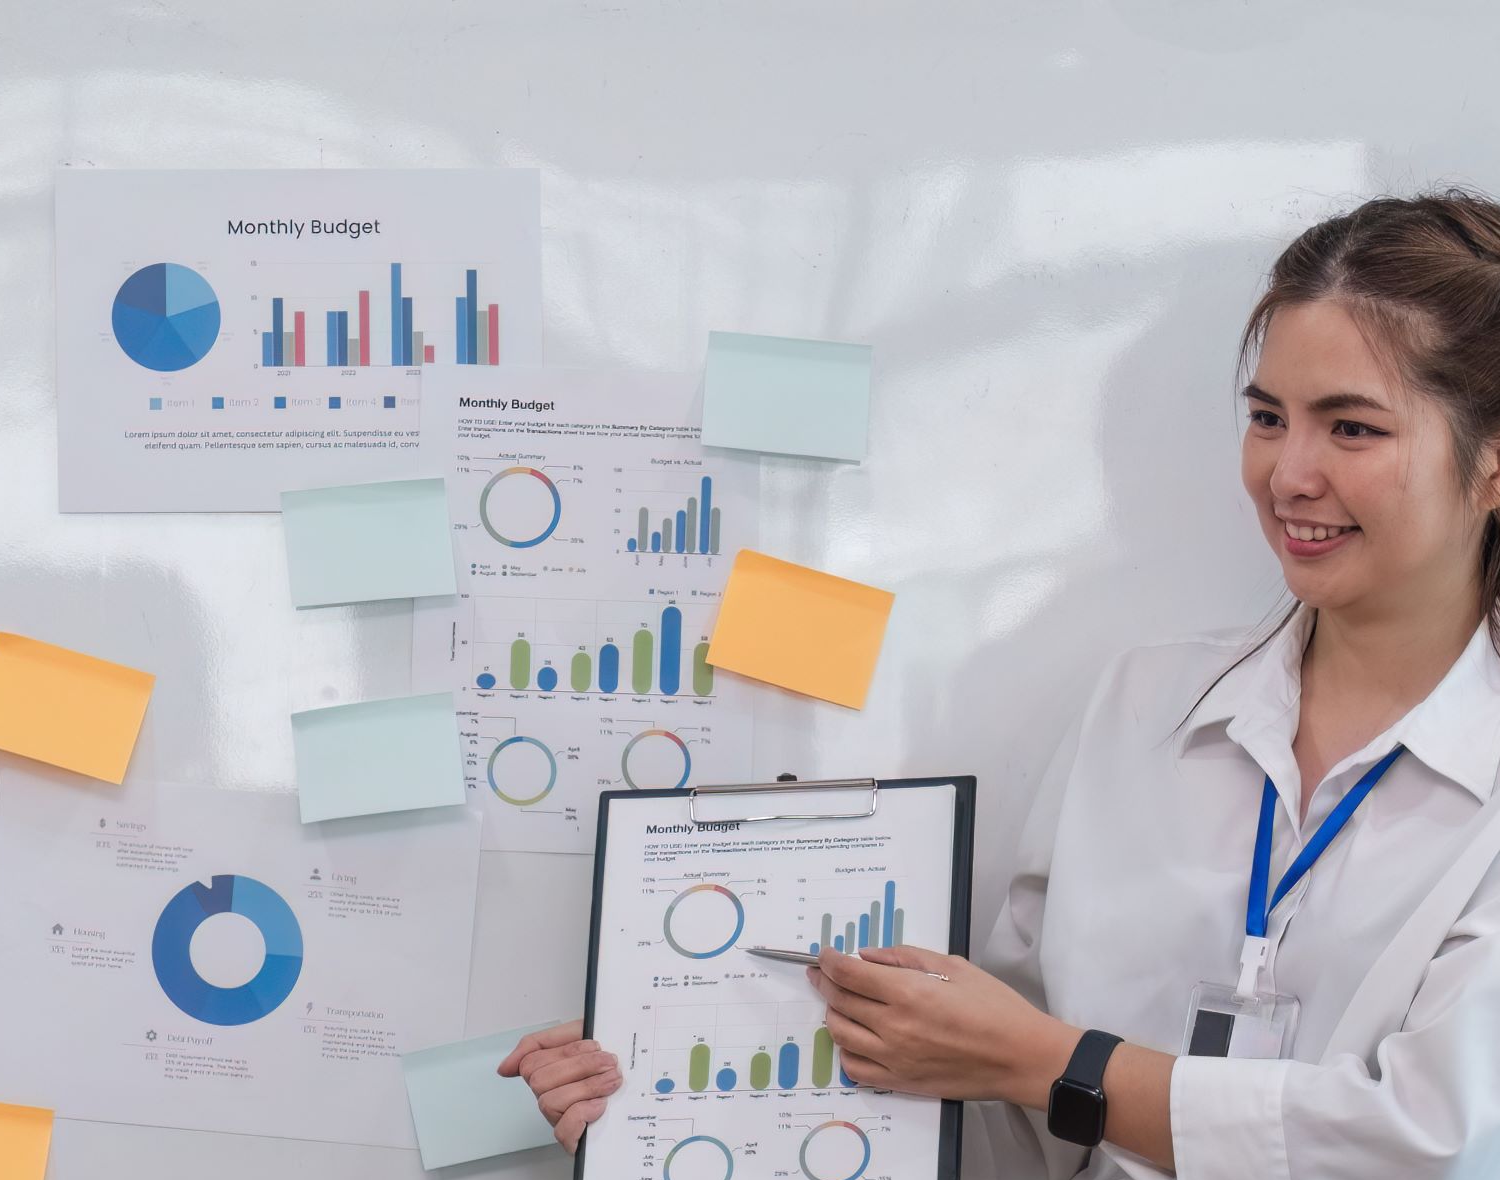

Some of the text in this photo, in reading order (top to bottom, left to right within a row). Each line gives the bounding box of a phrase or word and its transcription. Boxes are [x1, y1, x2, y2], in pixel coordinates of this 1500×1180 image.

[228, 219, 381, 239] Monthly Budget
[459, 397, 555, 412] Monthly Budget
[151, 431, 176, 439] ipsum
[200, 430, 210, 438] sit
[212, 431, 234, 439] amet,
[236, 430, 283, 438] consectetur
[285, 430, 325, 438] adipiscing
[327, 429, 341, 437] elit.
[343, 429, 392, 438] Suspendisse
[204, 441, 256, 450] Pellentesque
[276, 441, 304, 449] sapien,
[646, 822, 741, 835] Monthly Budget
